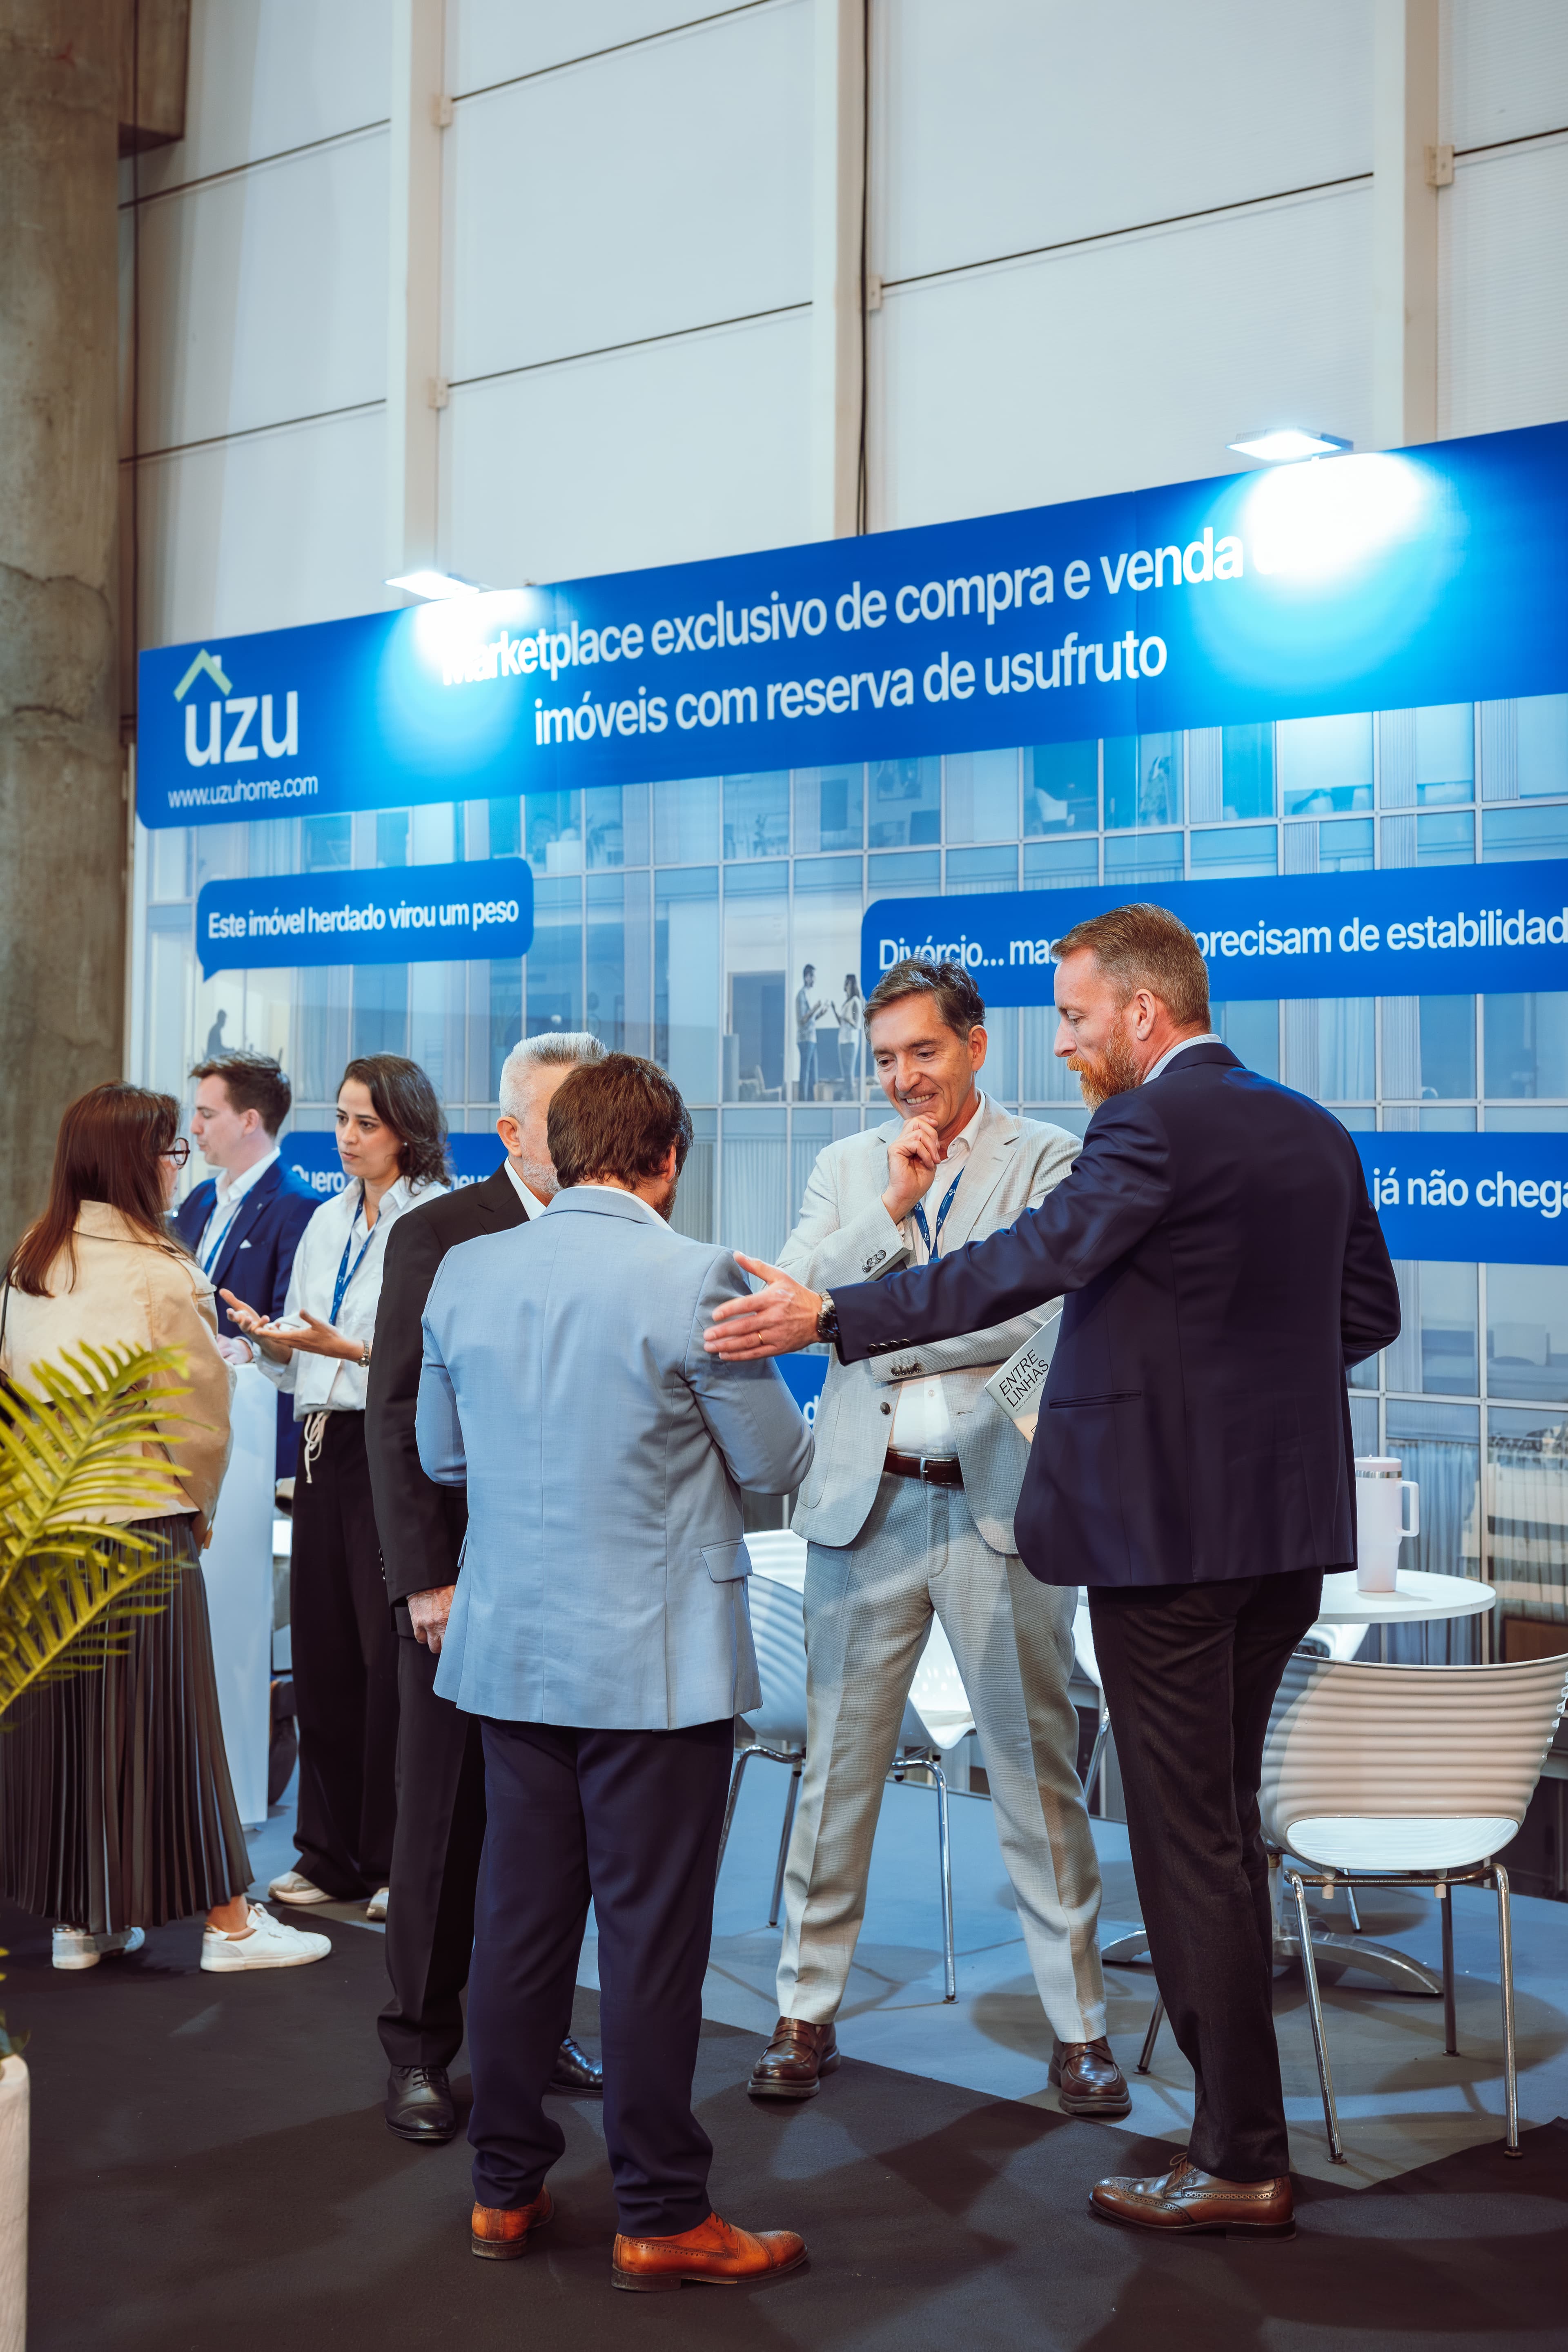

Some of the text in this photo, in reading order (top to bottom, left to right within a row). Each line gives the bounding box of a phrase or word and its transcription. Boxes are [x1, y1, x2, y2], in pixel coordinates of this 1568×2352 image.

[651, 590, 827, 655] exclusivo
[835, 581, 887, 632] de
[895, 565, 1054, 625] compra
[1064, 559, 1091, 600] e
[1100, 526, 1243, 595] venda
[535, 630, 1167, 745] imóveis com reserva de usufruto
[168, 776, 318, 808] www.uzuhome.com
[209, 900, 519, 939] Este imóvel herdado virou um peso
[1339, 917, 1380, 952] de
[1387, 907, 1568, 950] estabilidad
[1374, 1167, 1399, 1212] já
[1408, 1169, 1469, 1206] não
[999, 1349, 1038, 1396] ENTRE
[1006, 1359, 1049, 1408] LINHAS
[1028, 1388, 1037, 1398] CENTURY
